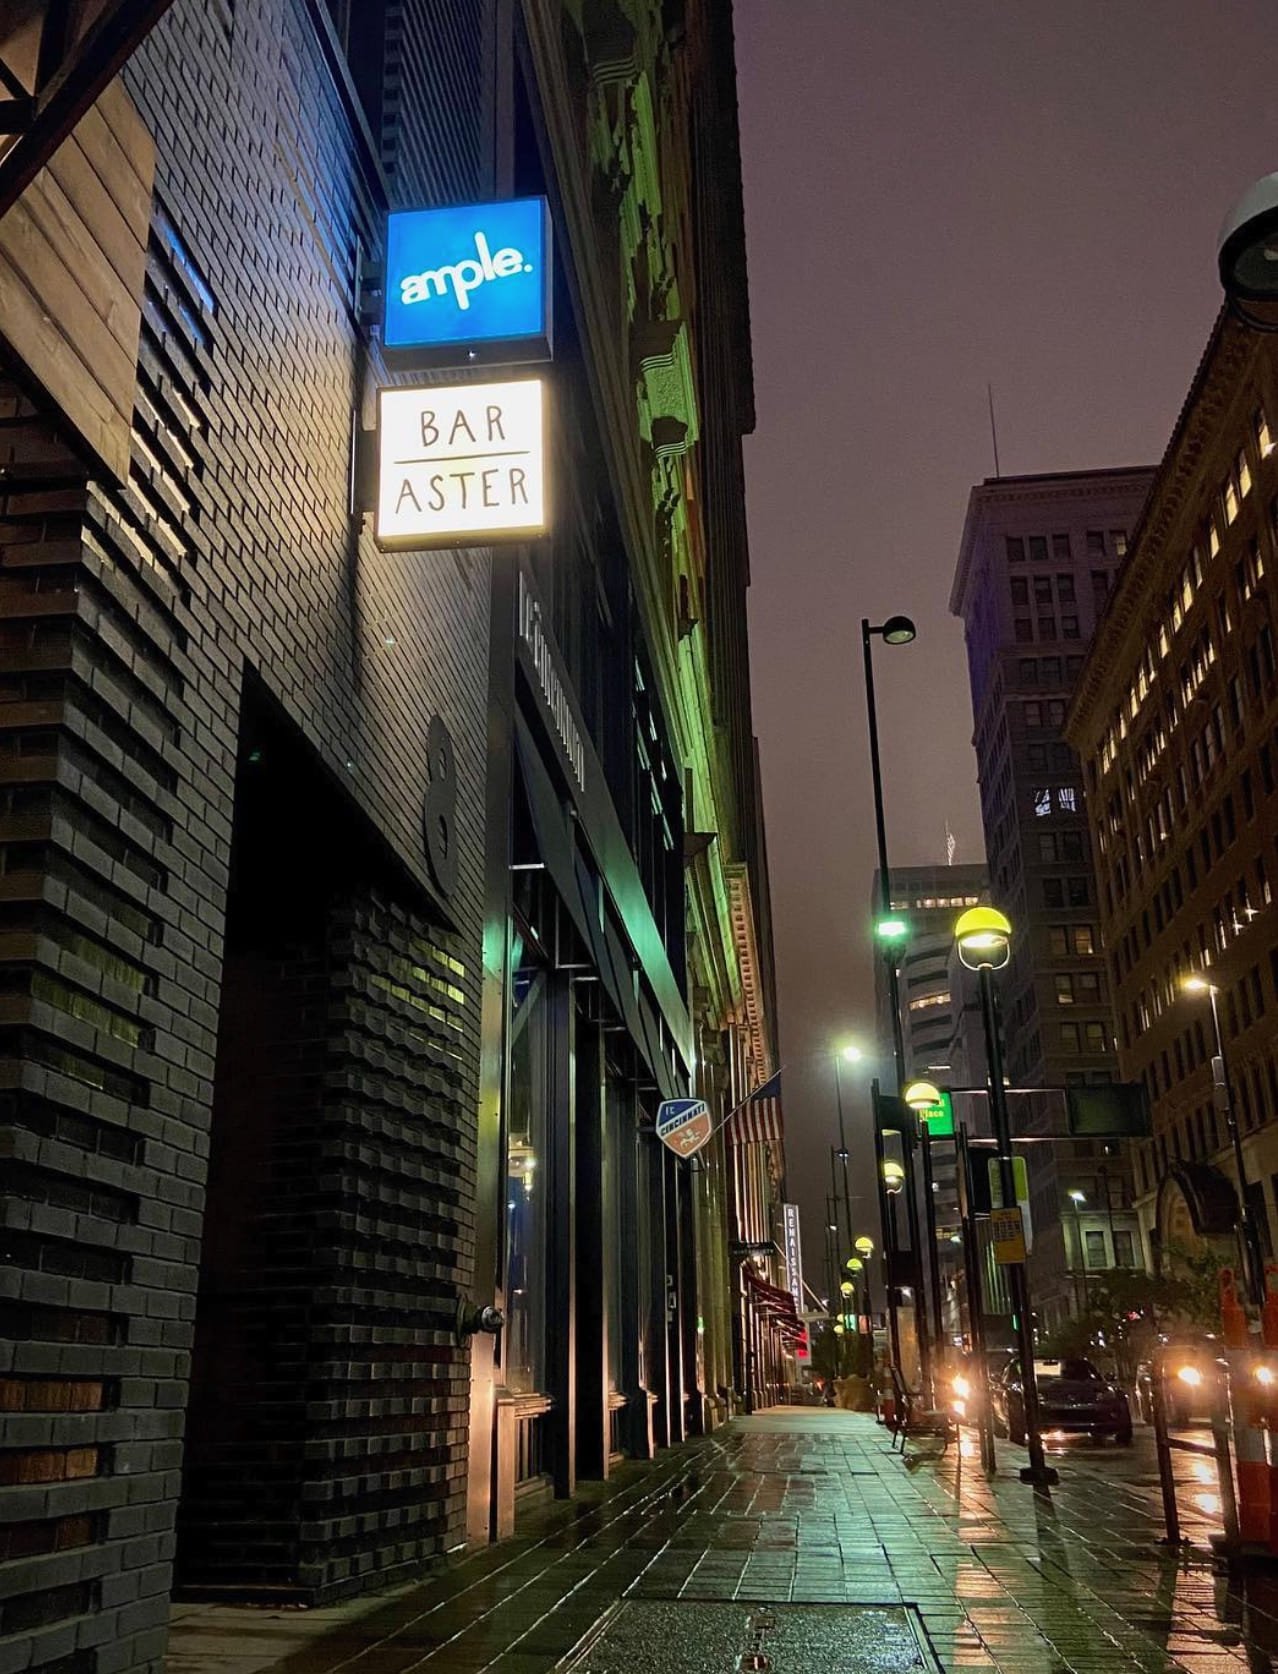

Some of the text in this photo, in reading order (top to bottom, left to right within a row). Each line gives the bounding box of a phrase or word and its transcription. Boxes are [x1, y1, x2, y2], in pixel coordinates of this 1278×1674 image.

[400, 231, 533, 311] ample.
[420, 405, 505, 447] BAR
[395, 468, 528, 514] ASTER
[660, 1104, 705, 1137] CINCINNATI
